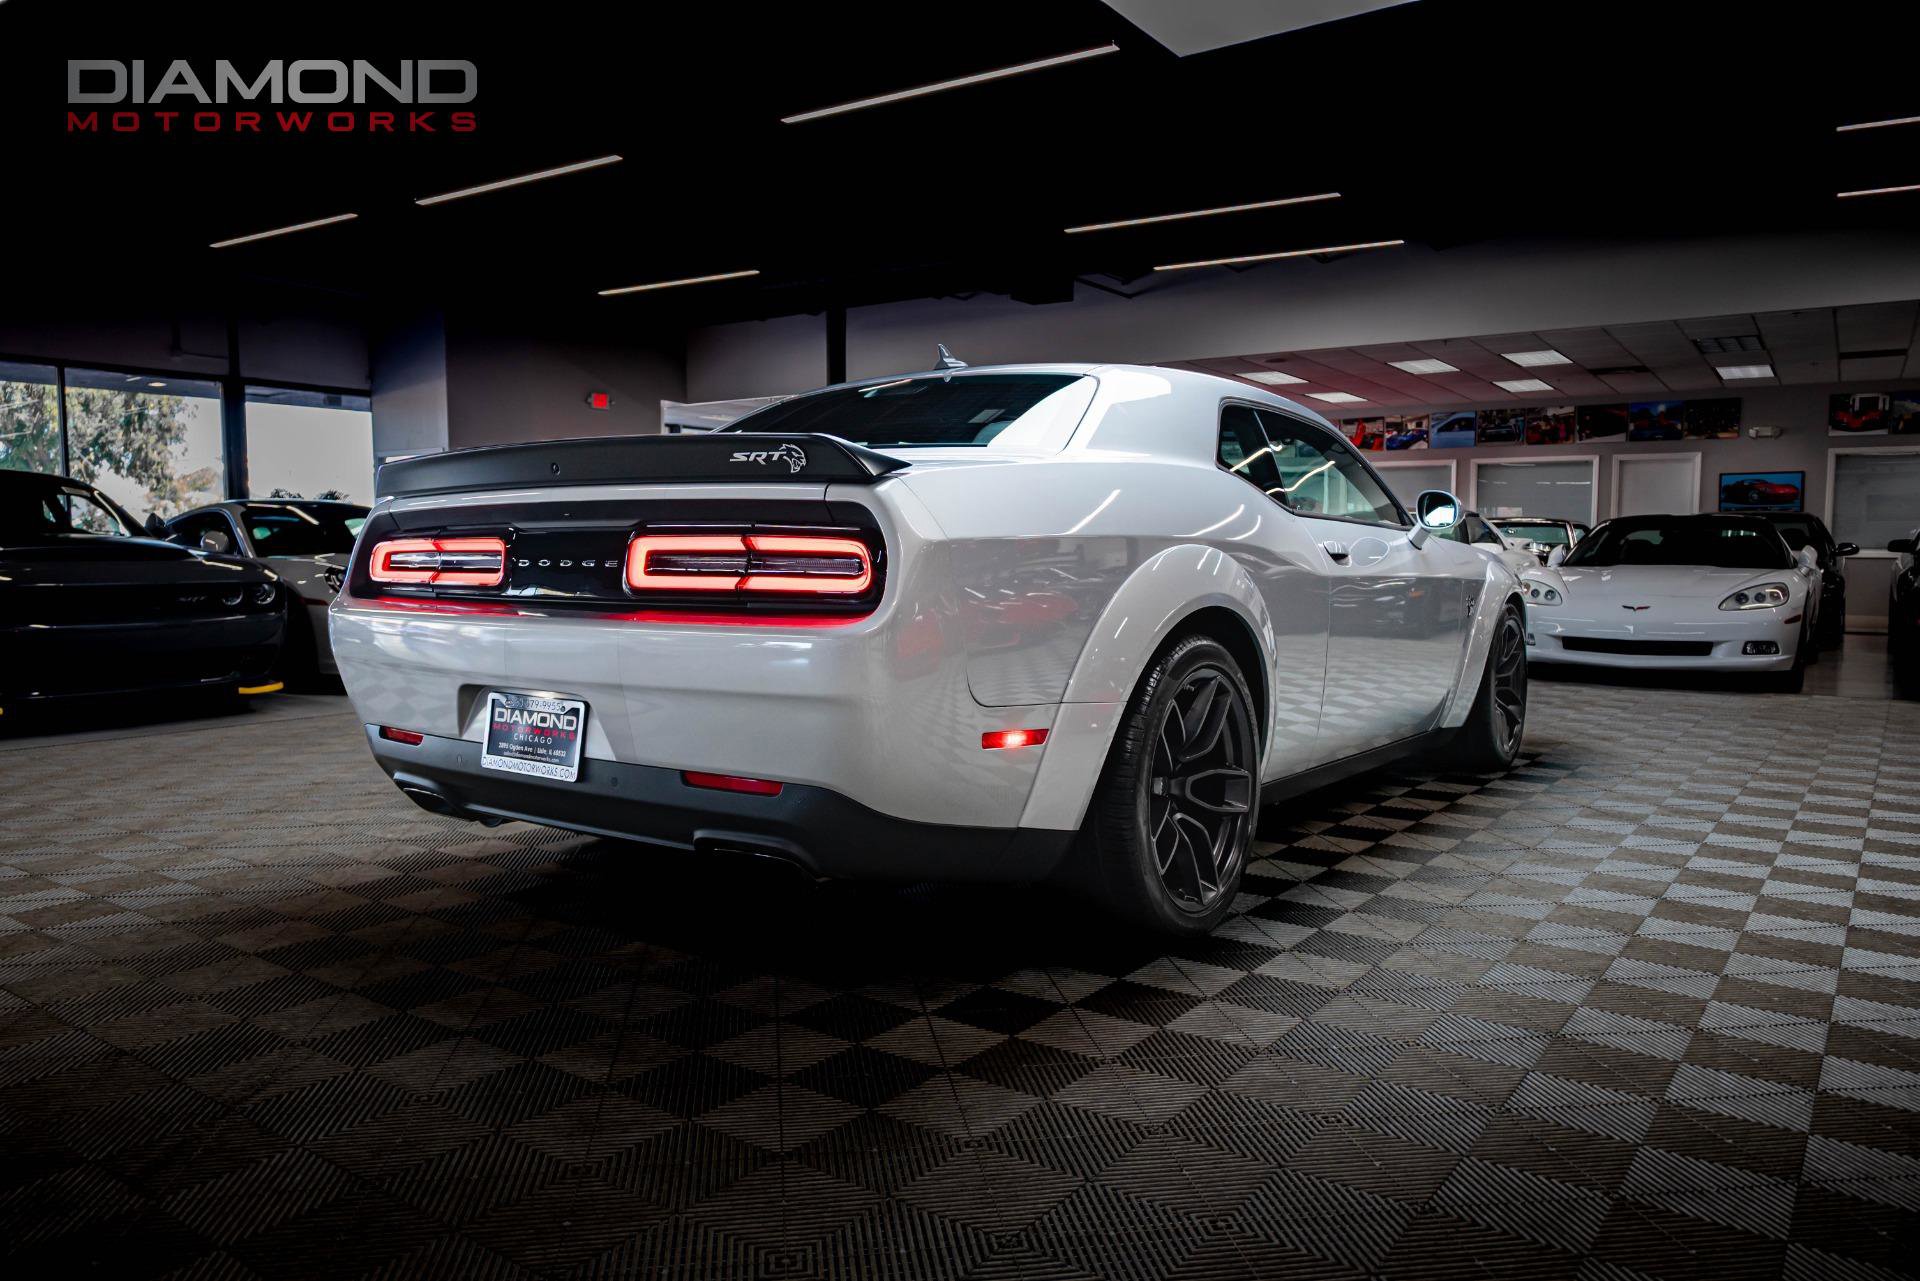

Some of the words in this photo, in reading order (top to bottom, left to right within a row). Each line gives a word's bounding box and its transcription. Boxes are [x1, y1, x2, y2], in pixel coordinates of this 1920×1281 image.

[729, 450, 787, 465] SRT
[518, 559, 618, 568] DODGE
[494, 707, 577, 731] DIAMOND
[492, 722, 576, 742] MOTORWORKS
[513, 733, 553, 745] CHICAGO
